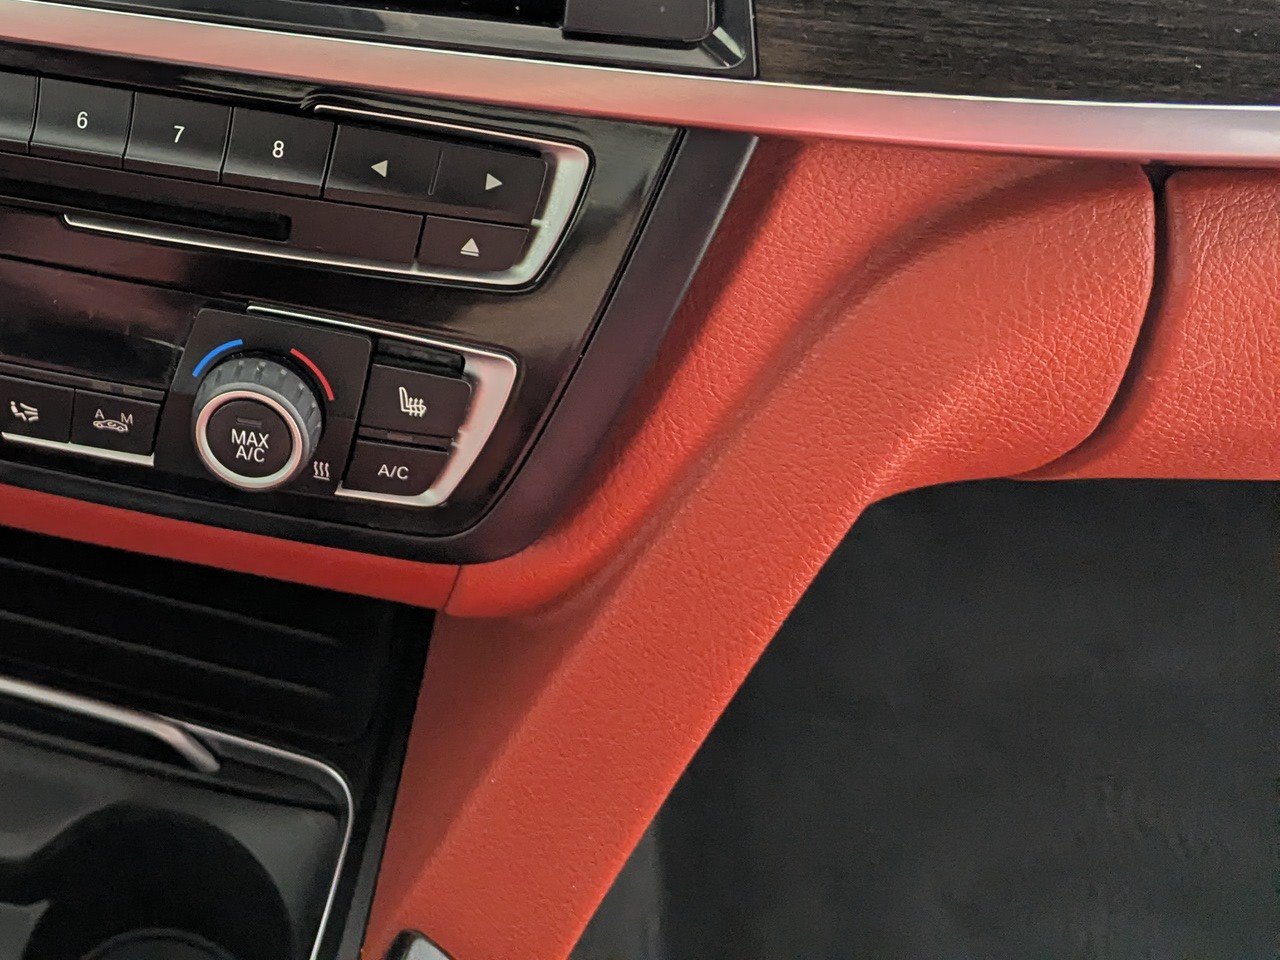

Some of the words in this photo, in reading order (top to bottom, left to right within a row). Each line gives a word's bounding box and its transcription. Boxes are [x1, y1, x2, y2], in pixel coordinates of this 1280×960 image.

[75, 111, 89, 129] 6
[173, 125, 186, 143] 7
[271, 140, 285, 159] 8
[94, 408, 105, 420] A
[120, 412, 134, 426] M
[230, 427, 270, 449] MAX
[235, 445, 266, 463] A/C
[377, 463, 410, 480] A/C
